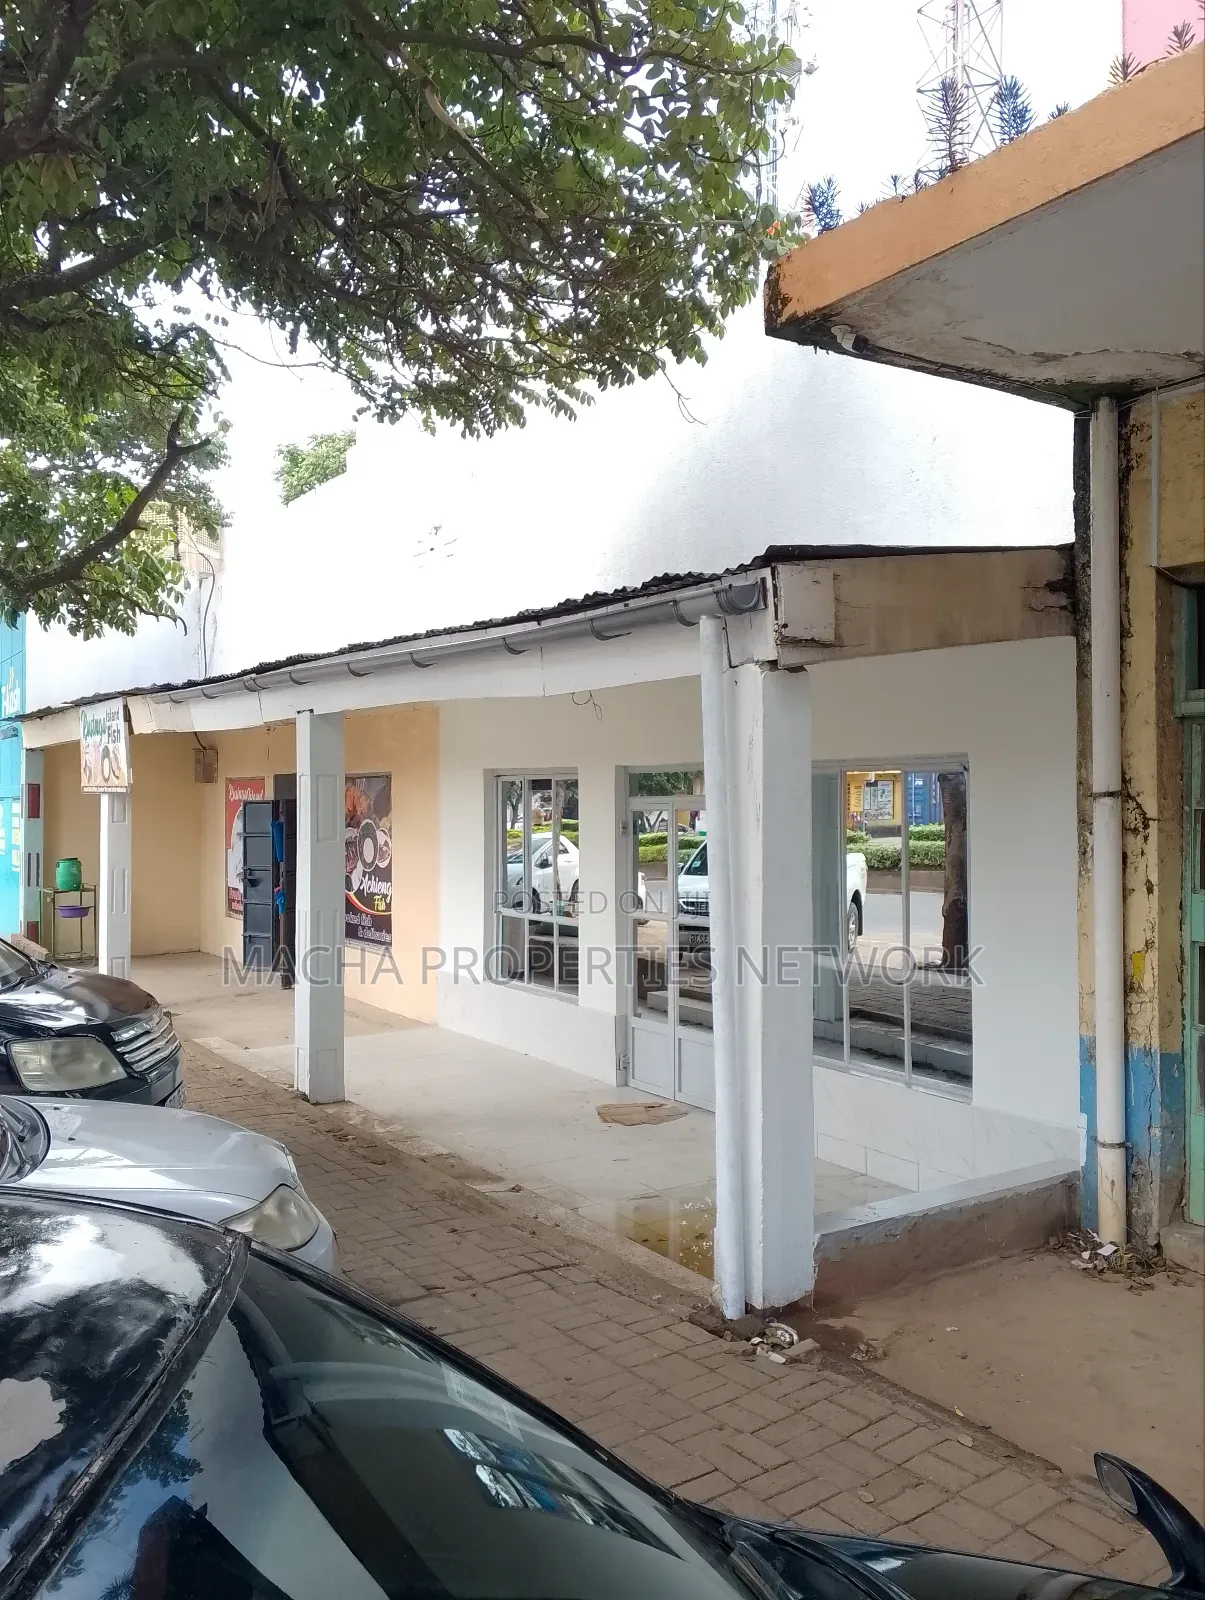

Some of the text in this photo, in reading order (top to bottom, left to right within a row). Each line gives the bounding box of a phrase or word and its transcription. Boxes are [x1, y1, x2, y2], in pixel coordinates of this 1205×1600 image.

[106, 706, 119, 722] Island
[107, 723, 120, 744] Fish
[360, 873, 392, 903] Achieng
[374, 895, 386, 911] Fish
[357, 925, 364, 938] &
